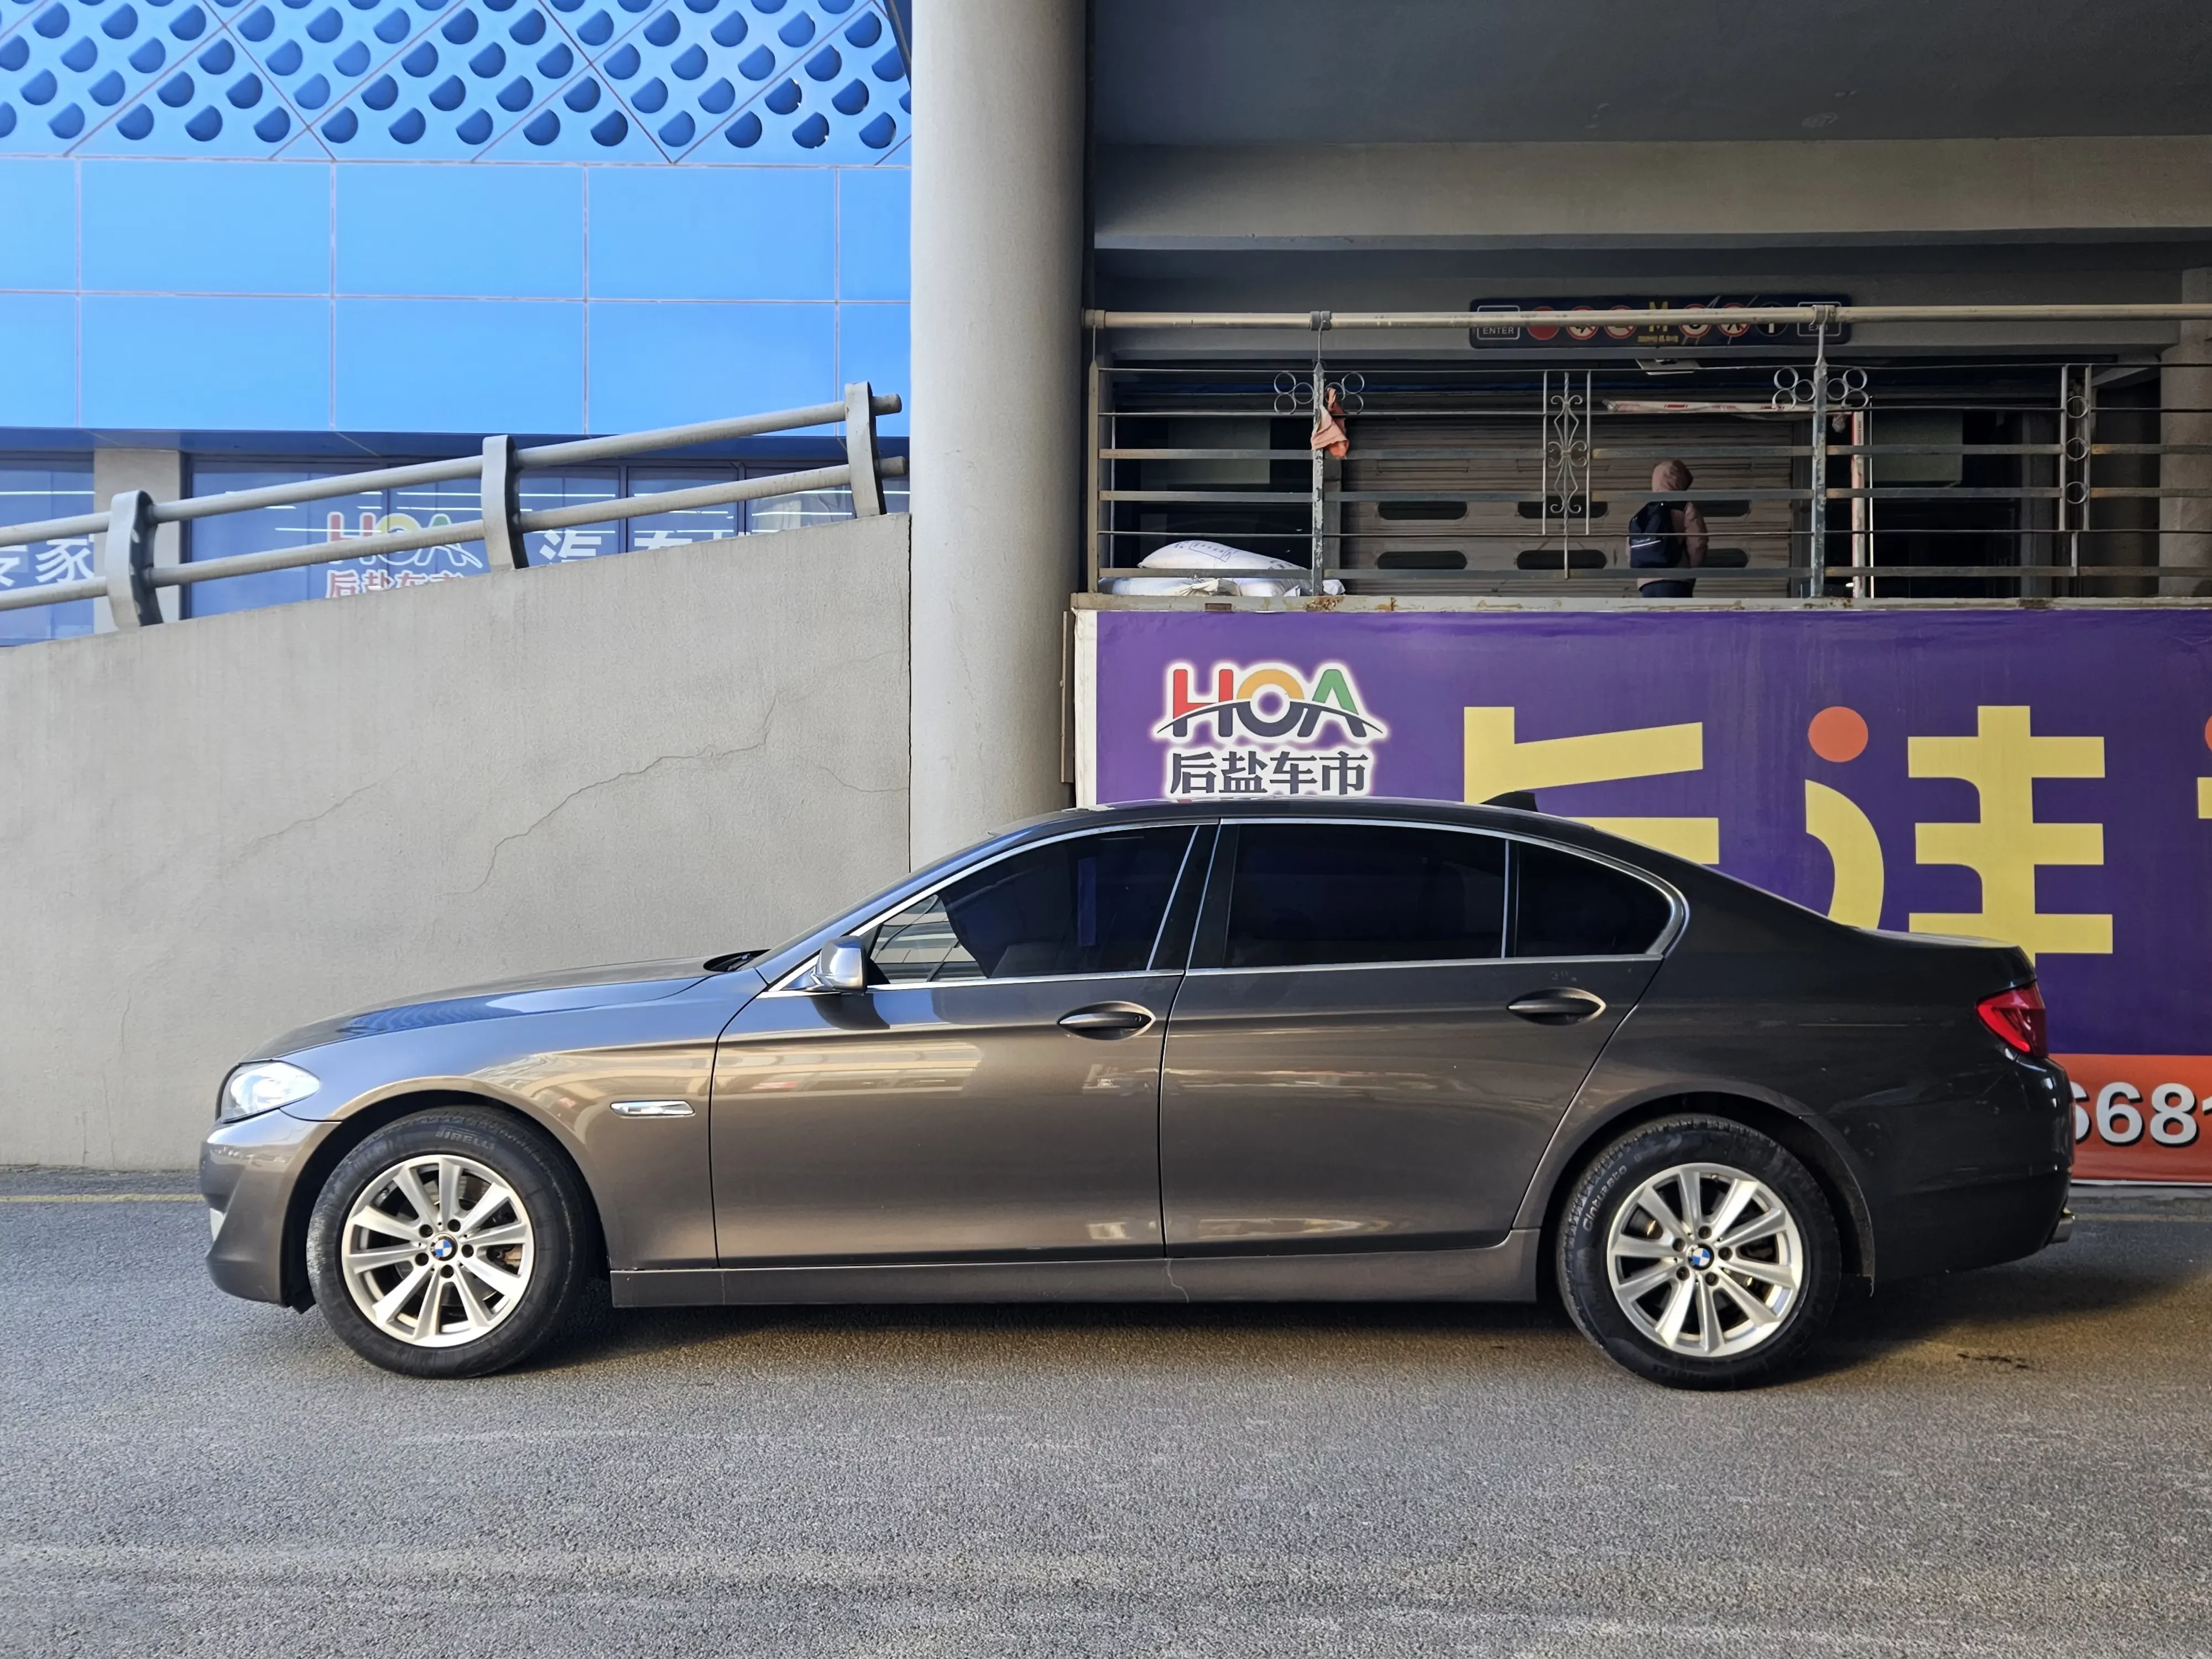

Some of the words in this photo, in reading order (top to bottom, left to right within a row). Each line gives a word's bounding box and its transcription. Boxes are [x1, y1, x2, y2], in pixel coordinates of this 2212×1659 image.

[1173, 668, 1368, 738] HOA
[1170, 751, 1369, 795] 后盐车市
[2070, 1081, 2212, 1146] 68
